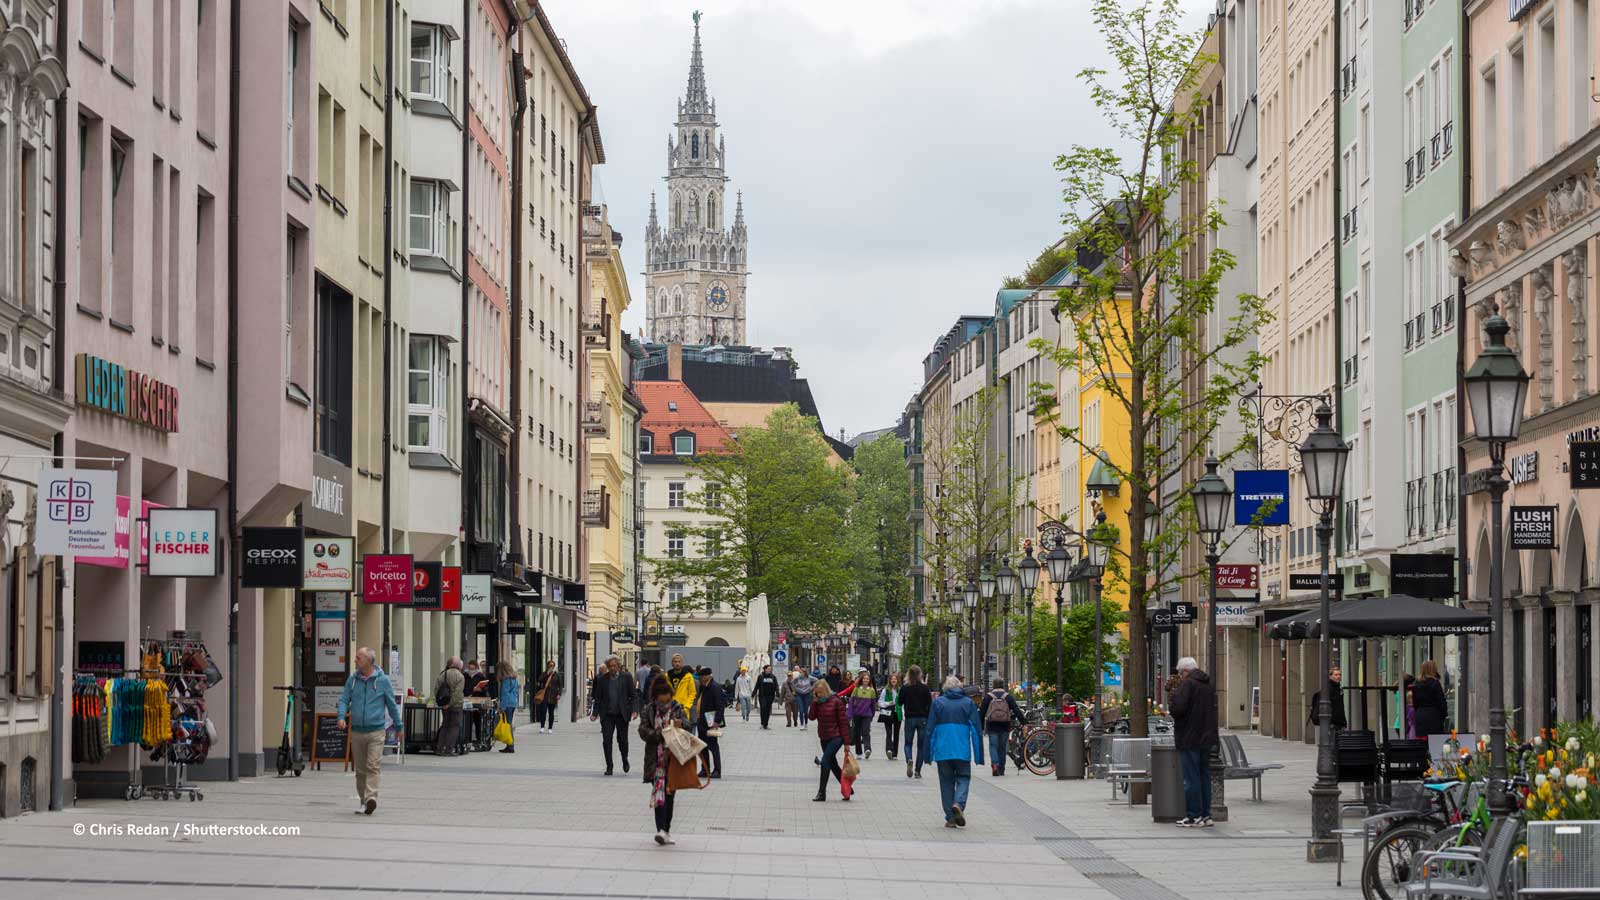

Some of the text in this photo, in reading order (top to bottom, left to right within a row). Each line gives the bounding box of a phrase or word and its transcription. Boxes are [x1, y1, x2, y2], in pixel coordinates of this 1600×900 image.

[84, 353, 180, 433] LEDER FISCHER
[1513, 511, 1551, 522] LUSH
[1513, 522, 1551, 532] FRESH
[69, 529, 107, 537] Katholischer
[154, 531, 209, 543] LEDER
[155, 543, 209, 555] FISCHER
[247, 549, 297, 559] GEOX
[1217, 566, 1239, 576] Tai Ji
[1217, 576, 1247, 586] Qi Gong
[1461, 625, 1490, 633] COFFEE
[319, 638, 341, 647] PGM
